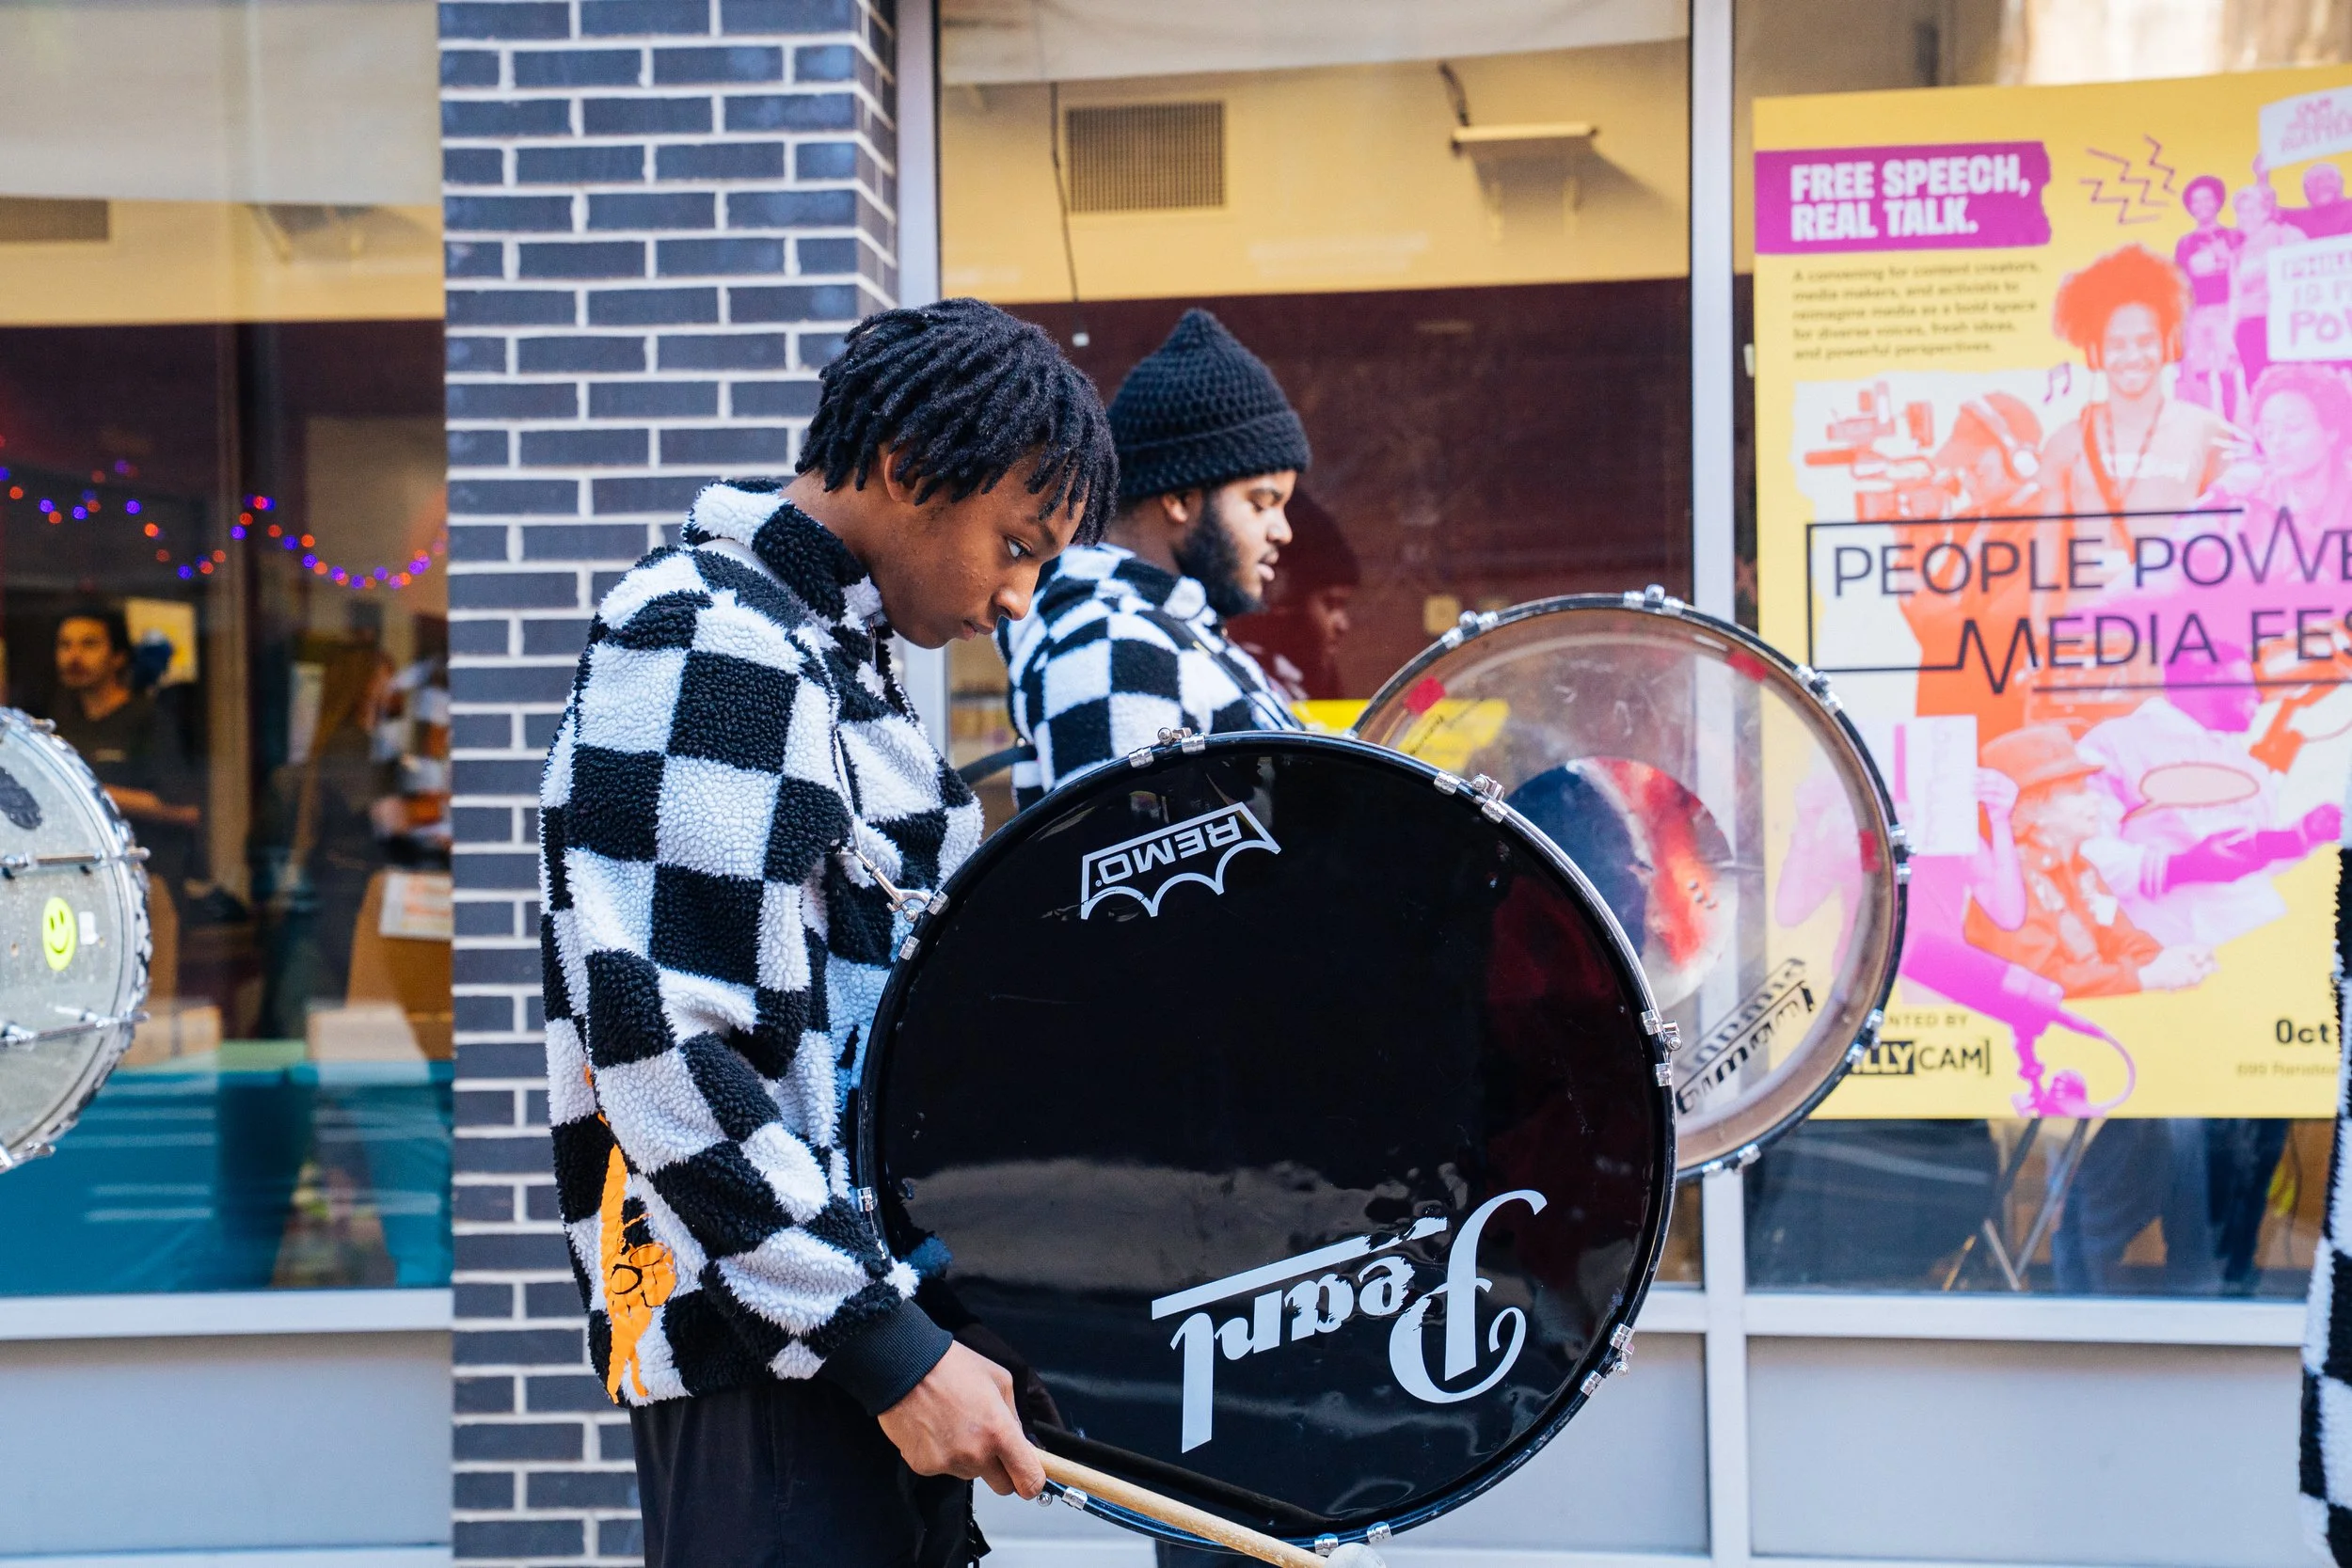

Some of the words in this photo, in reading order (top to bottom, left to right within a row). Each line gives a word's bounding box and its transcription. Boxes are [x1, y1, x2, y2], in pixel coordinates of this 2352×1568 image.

[1789, 161, 1876, 202] FREE
[1883, 153, 2031, 198] SPEECH,
[1789, 200, 1879, 243] REAL
[1883, 195, 1979, 238] TALK.
[2289, 308, 2352, 348] PO
[1834, 536, 2105, 598] PEOPLE
[1957, 610, 2218, 695] MEDIA
[1097, 815, 1243, 885] REMO
[1888, 1012, 1939, 1029] NTED
[1946, 1011, 1969, 1028] BY
[2275, 1019, 2330, 1045] Oct
[1168, 1189, 1548, 1454] Pearl
